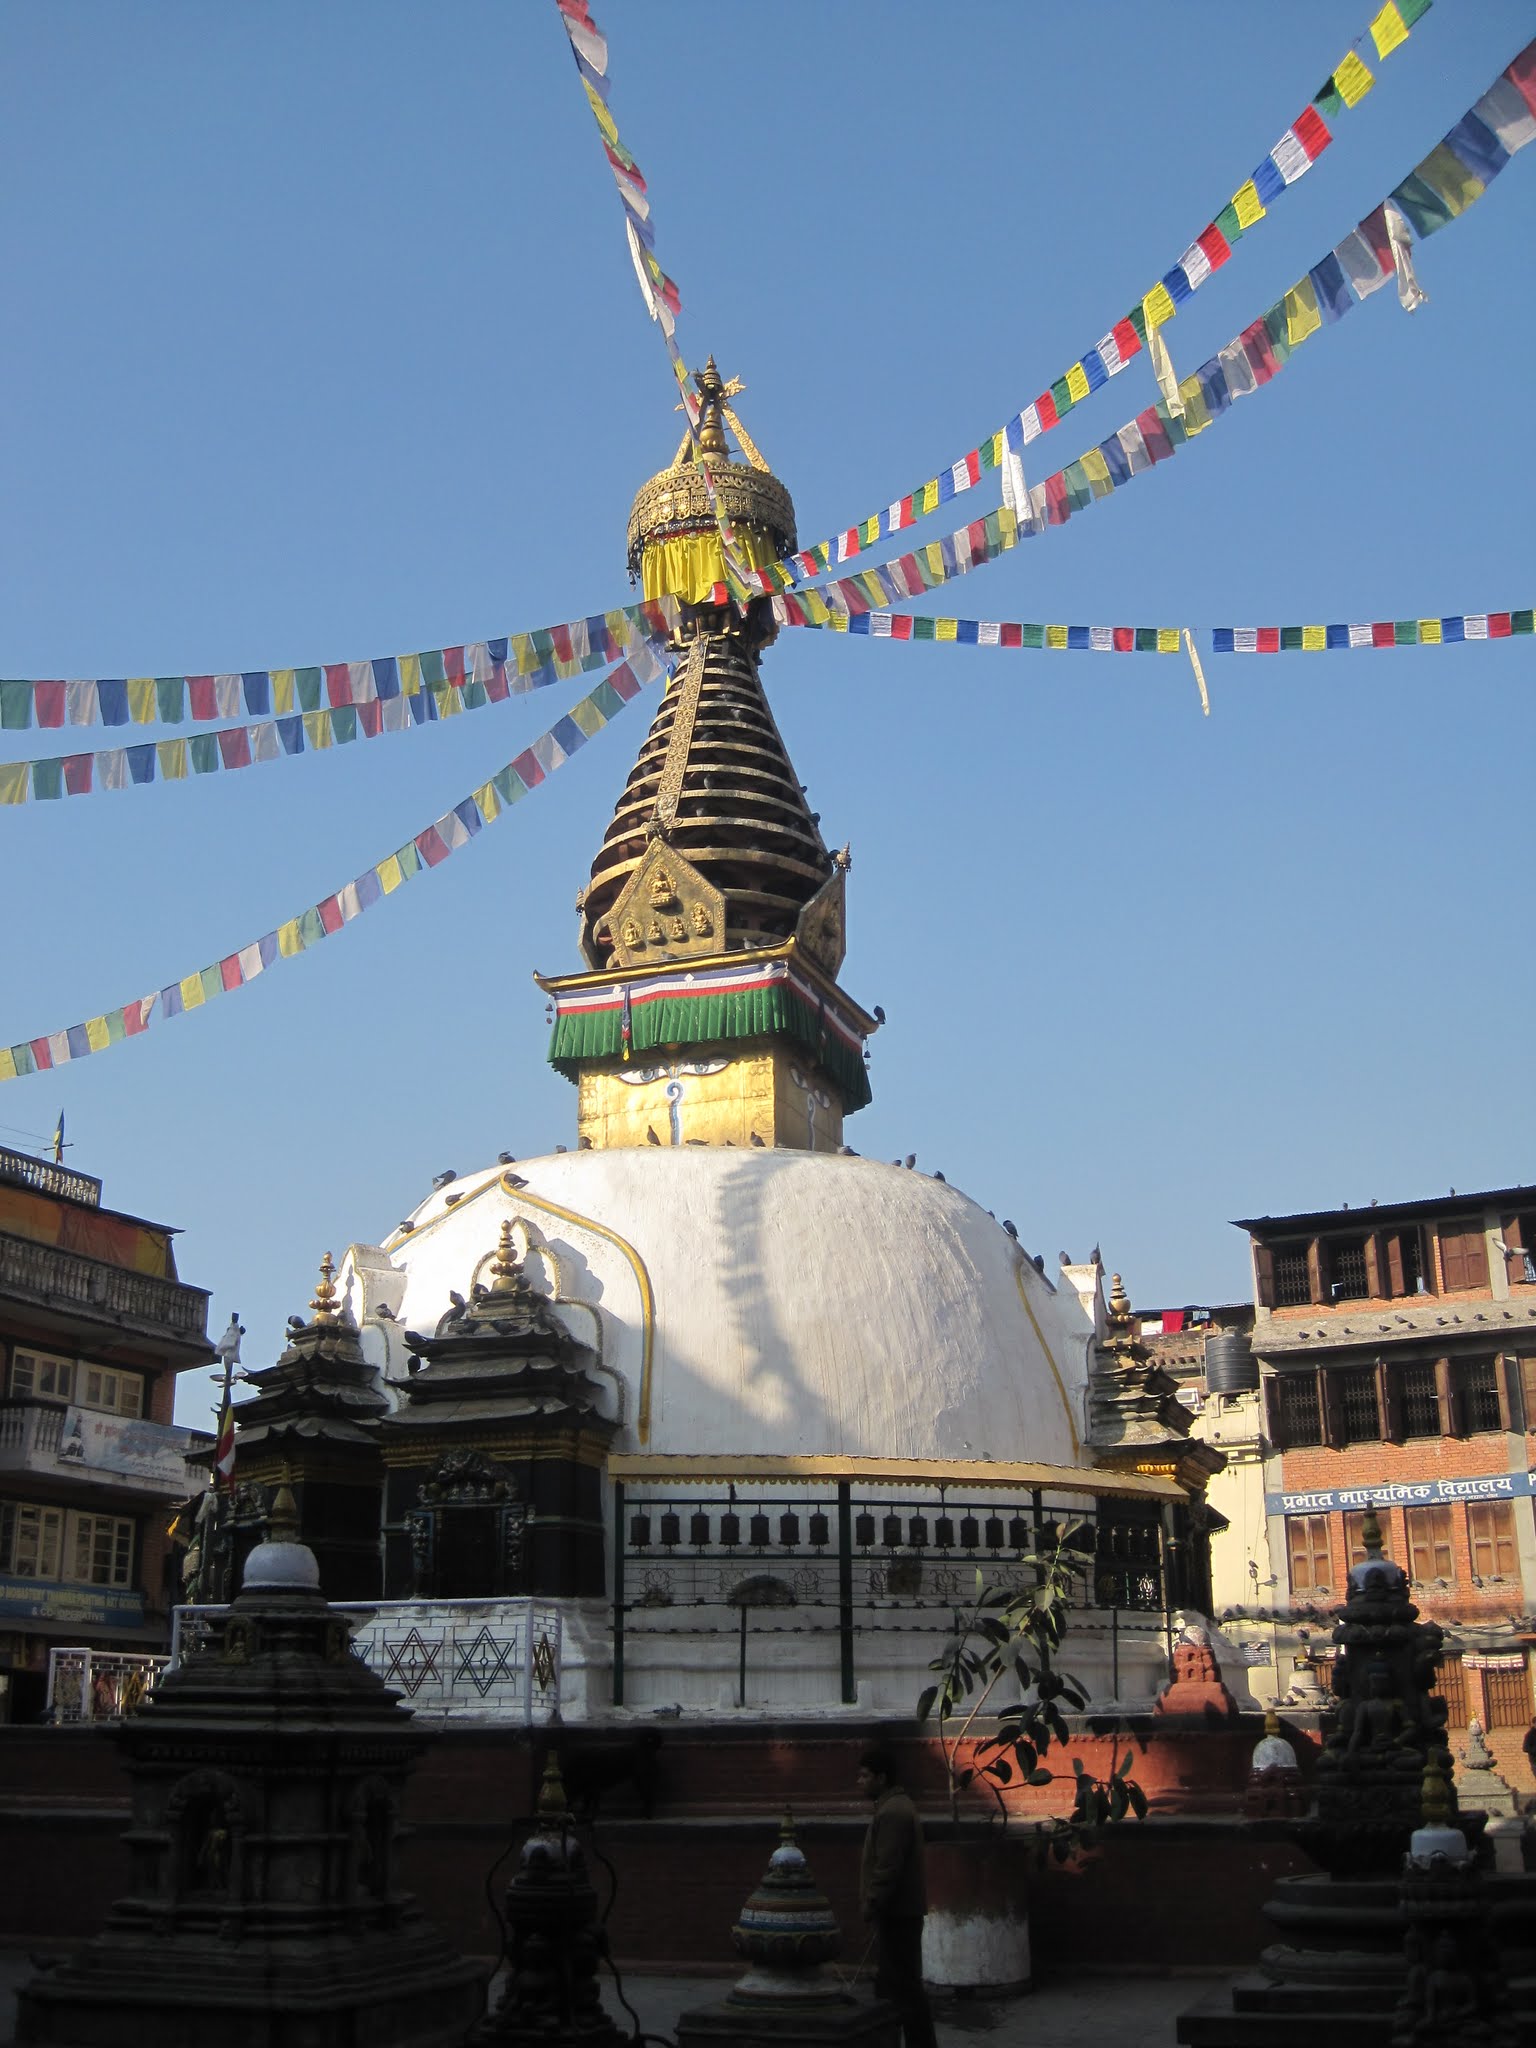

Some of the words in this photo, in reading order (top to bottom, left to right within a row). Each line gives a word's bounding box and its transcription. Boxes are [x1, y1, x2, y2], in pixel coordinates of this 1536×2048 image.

[1281, 1492, 1334, 1509] प्रभात
[1338, 1484, 1432, 1504] माध्यमिक
[1437, 1478, 1513, 1497] विद्यालय
